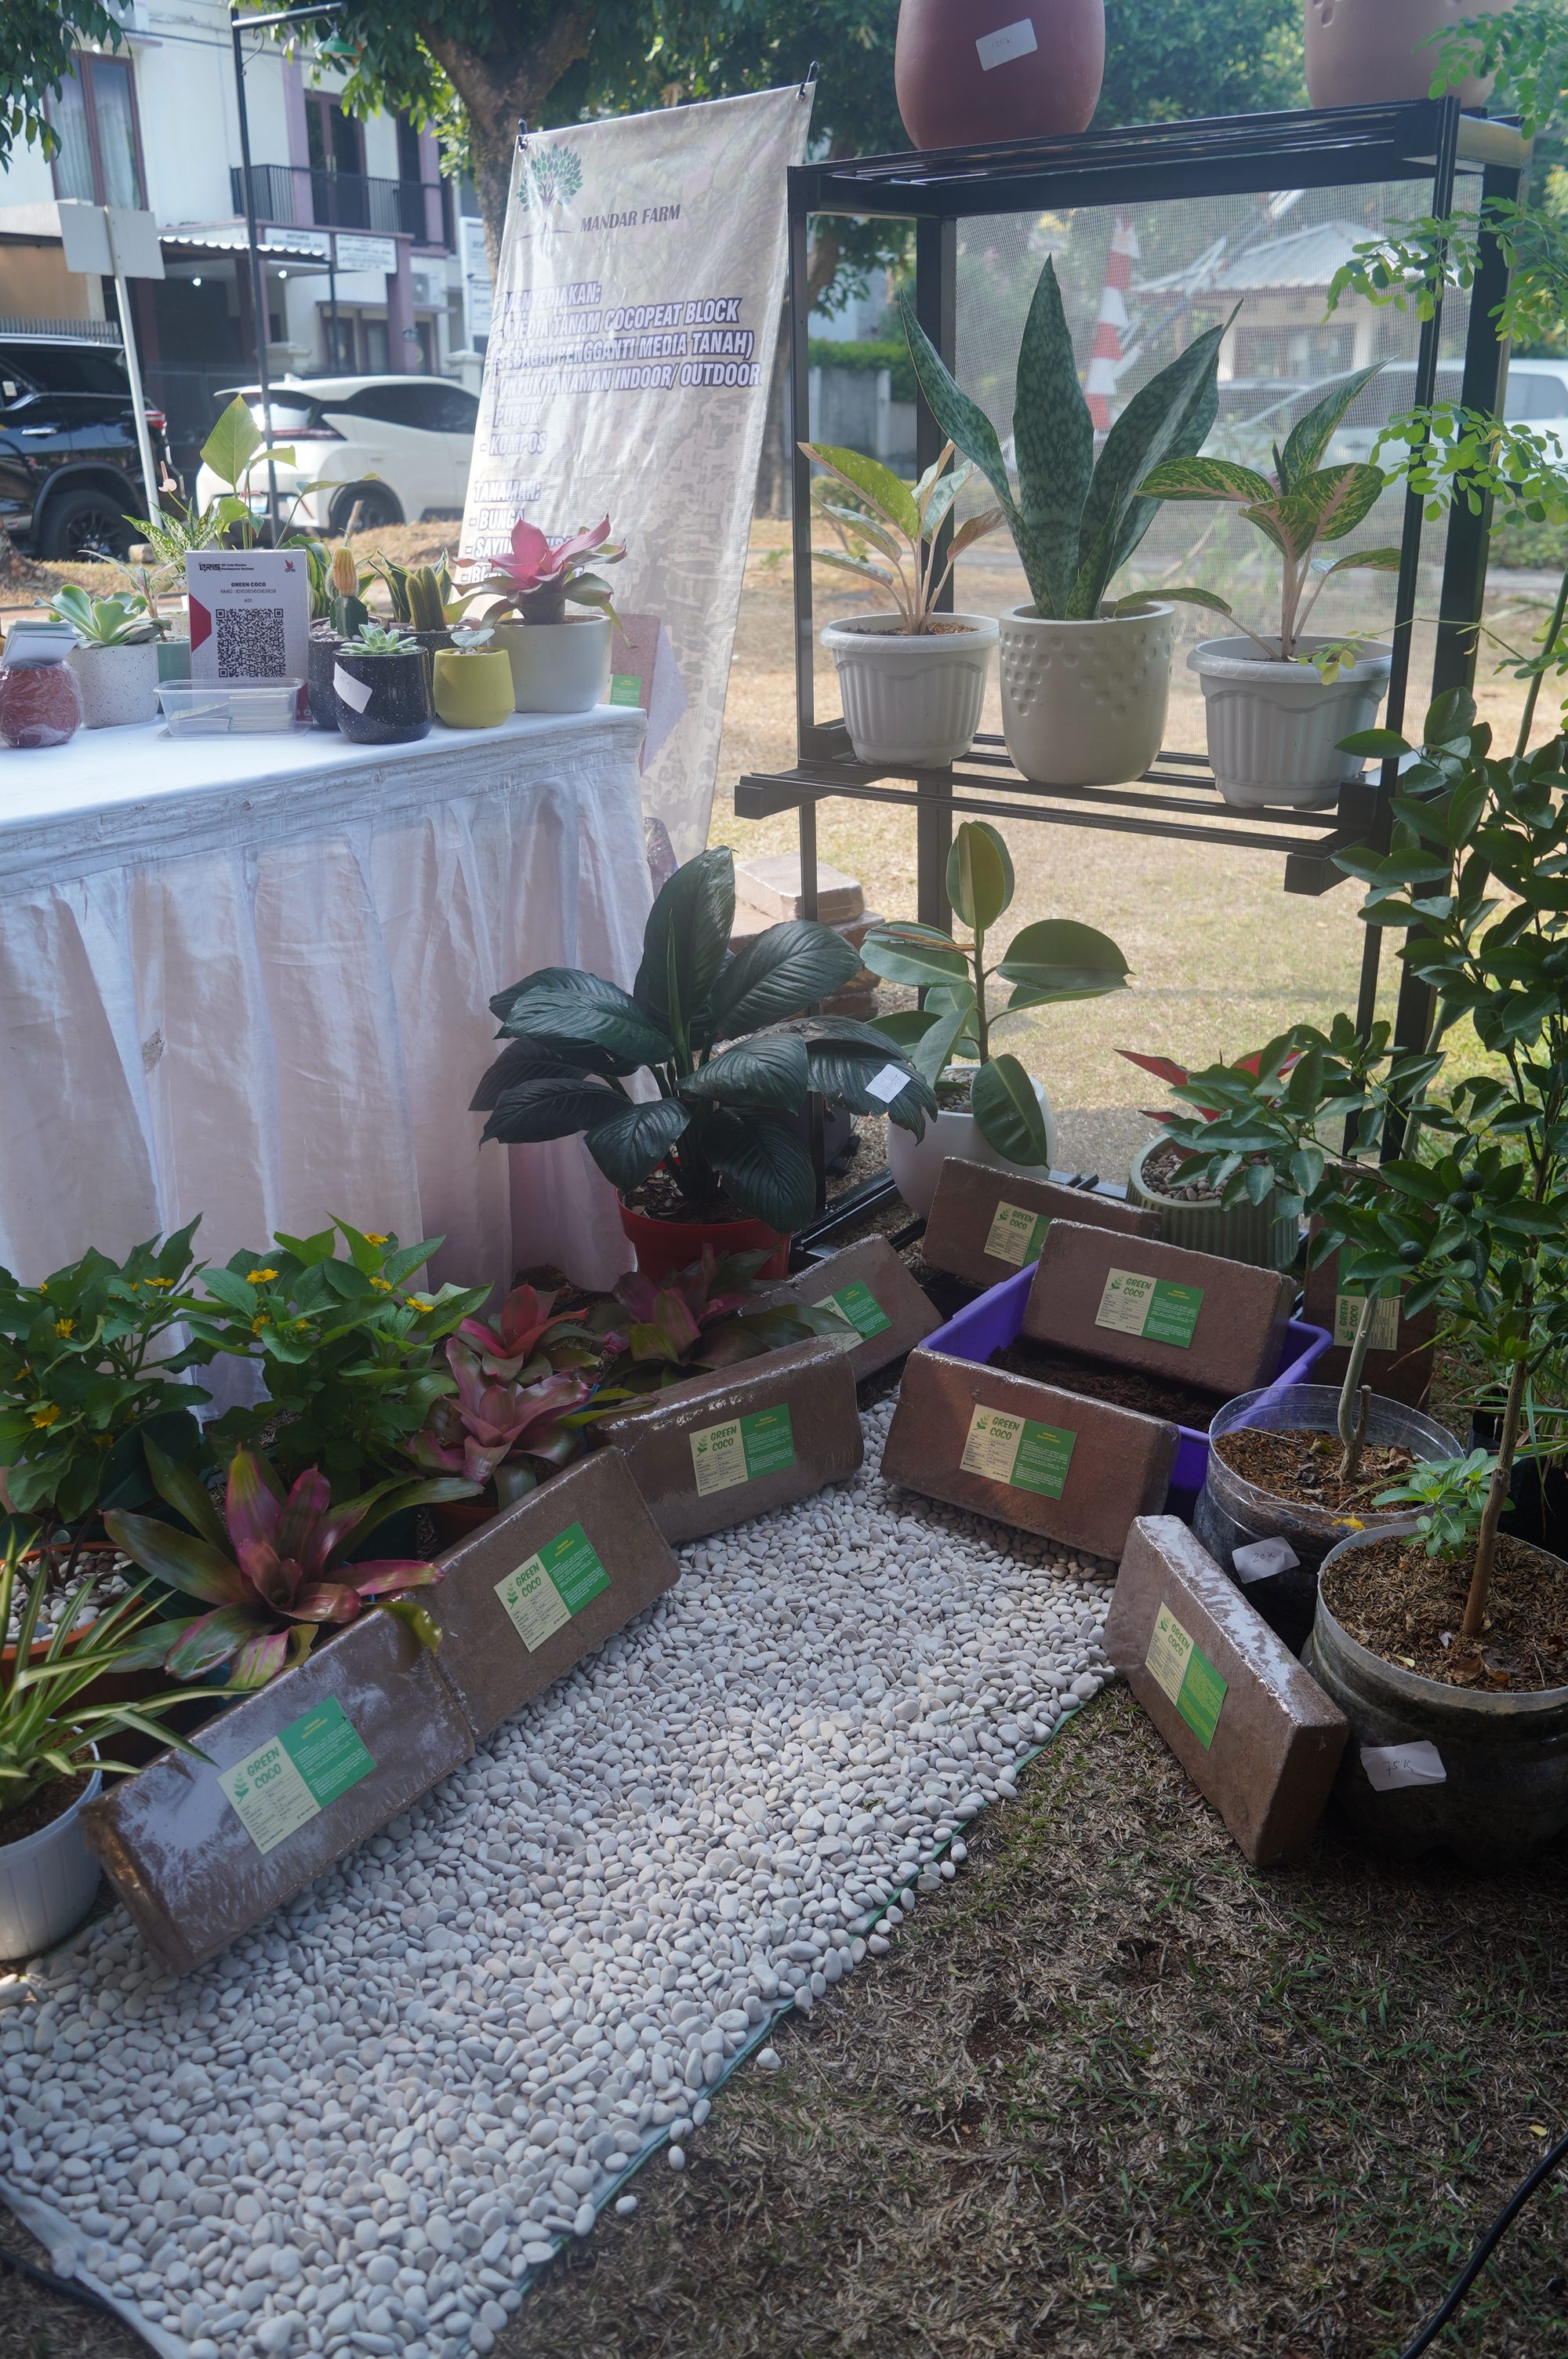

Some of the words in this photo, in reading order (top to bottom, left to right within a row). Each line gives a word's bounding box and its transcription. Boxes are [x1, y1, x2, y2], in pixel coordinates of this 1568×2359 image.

[580, 210, 638, 233] MANDAR
[641, 204, 681, 224] FARM
[552, 310, 603, 338] TANAM
[603, 301, 684, 333] COCOPEAT
[683, 297, 743, 326] BLOCK
[554, 336, 637, 365] PENGGANTI
[637, 331, 688, 360] MEDIA
[690, 329, 755, 361] TANAH)
[544, 368, 614, 394] TANAMAN
[612, 362, 681, 391] INDOOR/
[679, 362, 762, 387] OUTDOOR
[493, 402, 541, 428] PUPUK
[490, 432, 547, 456] KOMPOS
[1009, 1218, 1028, 1230] COCO
[1011, 1210, 1035, 1223] GREEN
[1123, 1287, 1145, 1299] COCO
[1126, 1278, 1152, 1290] GREEN
[1339, 1299, 1349, 1327] GREEN
[1349, 1304, 1359, 1328] COCO
[710, 1425, 737, 1441] GREEN
[989, 1427, 1012, 1441] COCO
[992, 1416, 1021, 1431] GREEN
[712, 1438, 734, 1452] COCO
[515, 1561, 540, 1587] GREEN
[521, 1576, 542, 1598] COCO
[1167, 1634, 1184, 1657] COCO
[1171, 1623, 1190, 1651] GREEN
[246, 1746, 281, 1777] GREEN
[253, 1763, 282, 1790] COCO
